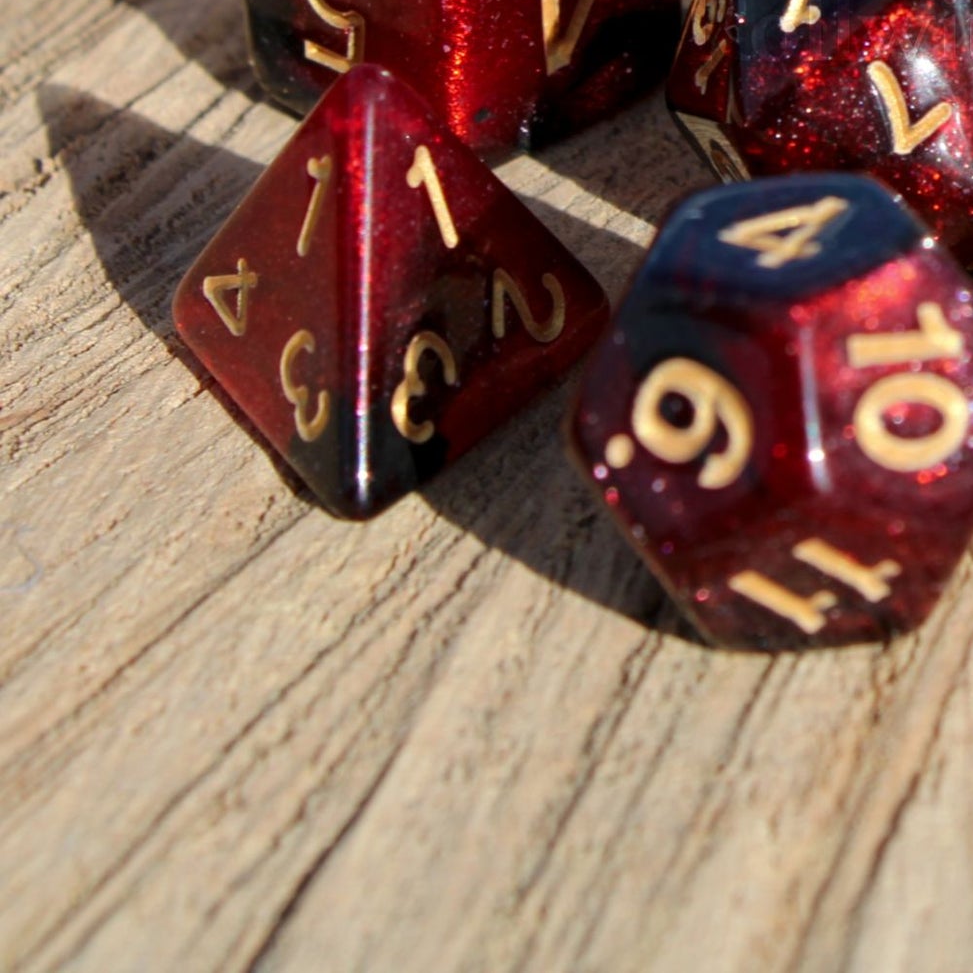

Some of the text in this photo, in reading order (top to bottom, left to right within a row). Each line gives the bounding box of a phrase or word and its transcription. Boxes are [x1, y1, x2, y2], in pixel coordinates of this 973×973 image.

[866, 60, 954, 156] 7
[296, 154, 332, 257] 1
[406, 144, 459, 249] 1
[718, 196, 849, 269] 4
[203, 257, 260, 337] 4
[492, 267, 566, 344] 2
[280, 330, 329, 443] 3
[391, 330, 457, 444] 3
[846, 301, 970, 473] 10
[728, 538, 903, 635] 11
